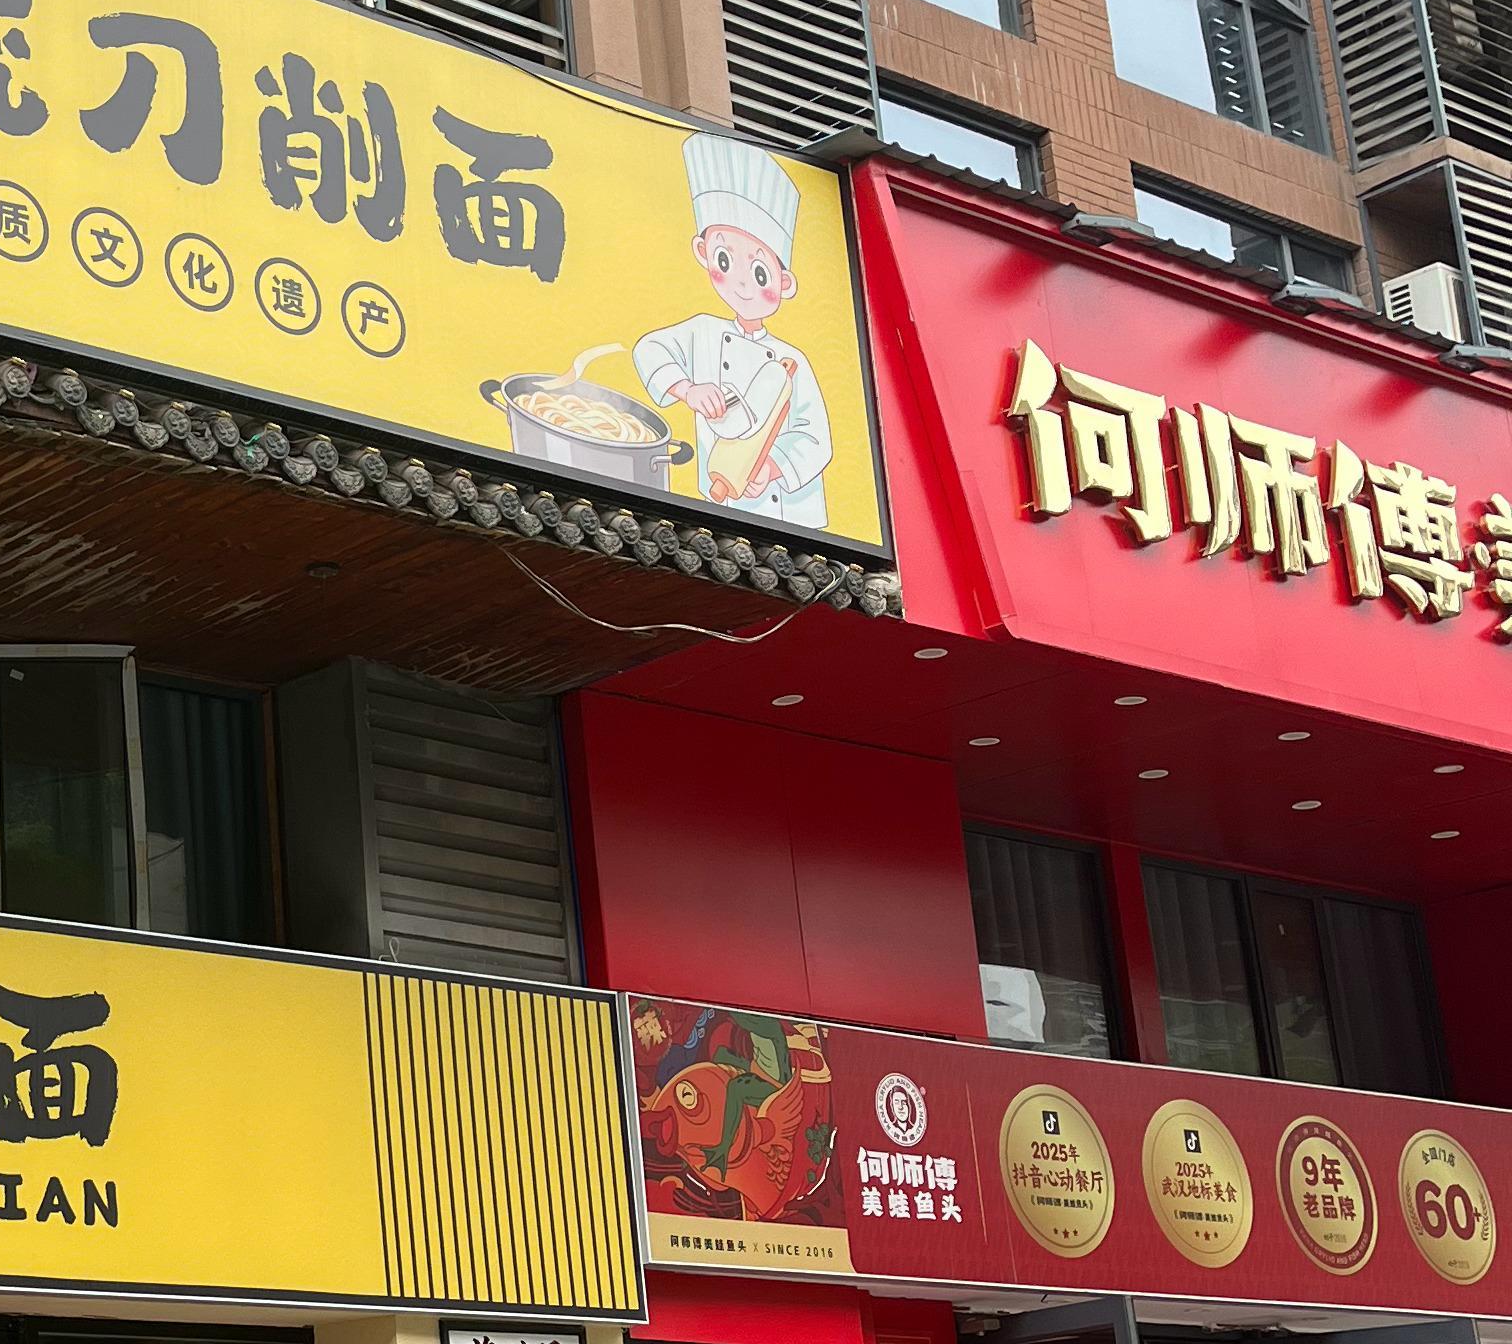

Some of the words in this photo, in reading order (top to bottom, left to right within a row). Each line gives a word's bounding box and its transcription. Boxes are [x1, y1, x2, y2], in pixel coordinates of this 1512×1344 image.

[1031, 1141, 1080, 1164] 2025年
[1421, 1146, 1456, 1168] 全国门店
[856, 1146, 958, 1191] 何师傅
[1012, 1162, 1104, 1194] 抖音心动餐厅
[1175, 1161, 1214, 1180] 2025年
[1301, 1153, 1345, 1193] 9年
[1161, 1175, 1238, 1204] 武汉地标美食
[860, 1186, 963, 1224] 美蛙鱼头
[1303, 1191, 1357, 1222] 老品牌
[764, 1243, 800, 1256] SINCE
[806, 1246, 834, 1259] 2016
